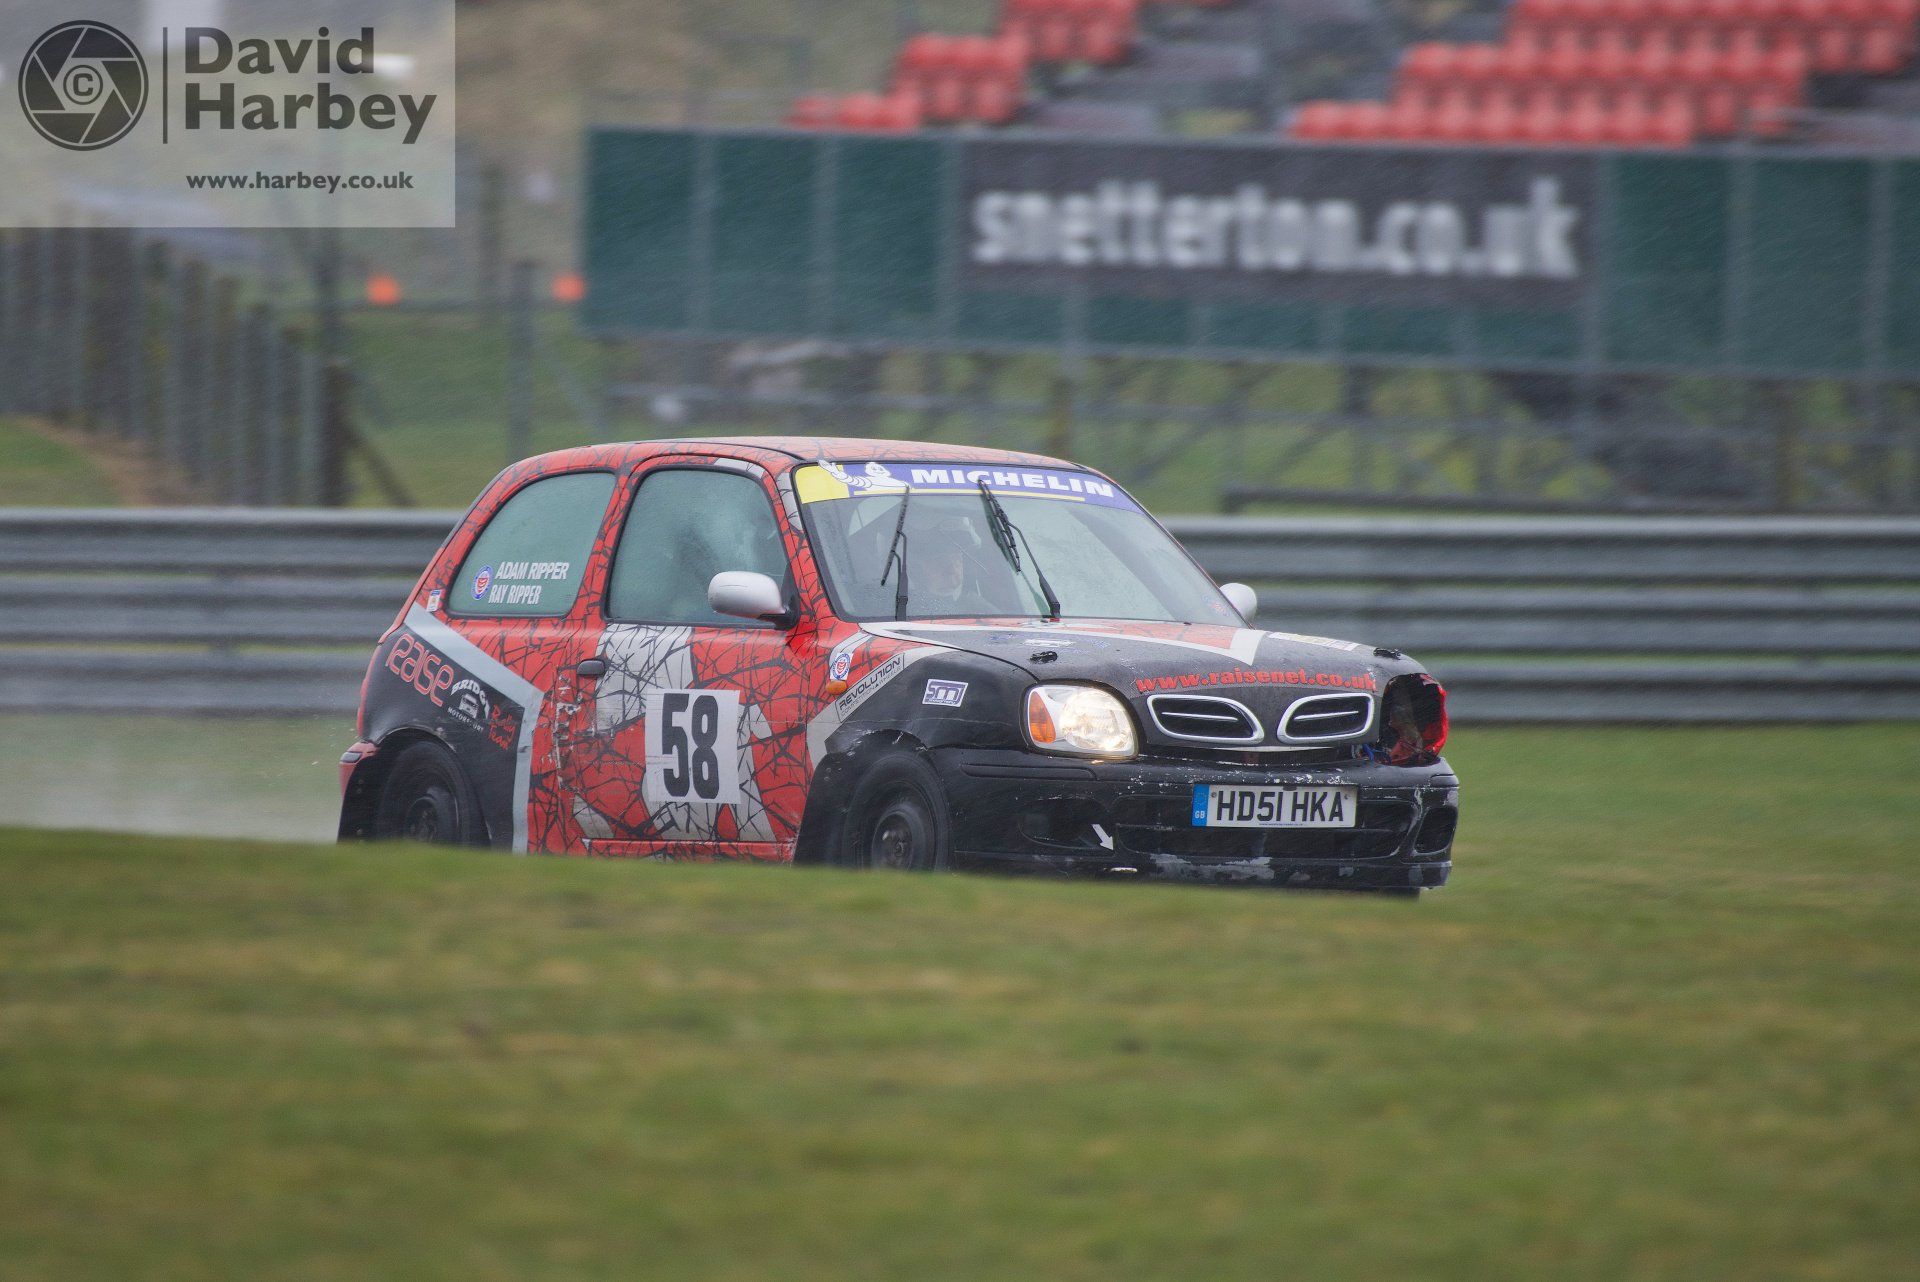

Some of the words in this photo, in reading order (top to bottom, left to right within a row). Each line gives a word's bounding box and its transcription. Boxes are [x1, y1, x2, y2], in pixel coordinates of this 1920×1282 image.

[973, 176, 1580, 279] snetterton.co.uk
[911, 468, 1115, 498] MICHELIN
[494, 561, 529, 580] ADAM
[527, 562, 570, 580] RIPPER
[488, 584, 510, 604] RAY
[506, 585, 542, 605] RIPPER
[839, 657, 901, 711] REVOLUTION
[1135, 667, 1379, 693] www.raisenet.co.uk
[661, 692, 719, 799] 58
[1194, 810, 1206, 819] GB
[1216, 790, 1284, 821] HD51
[1291, 791, 1344, 822] HKA
